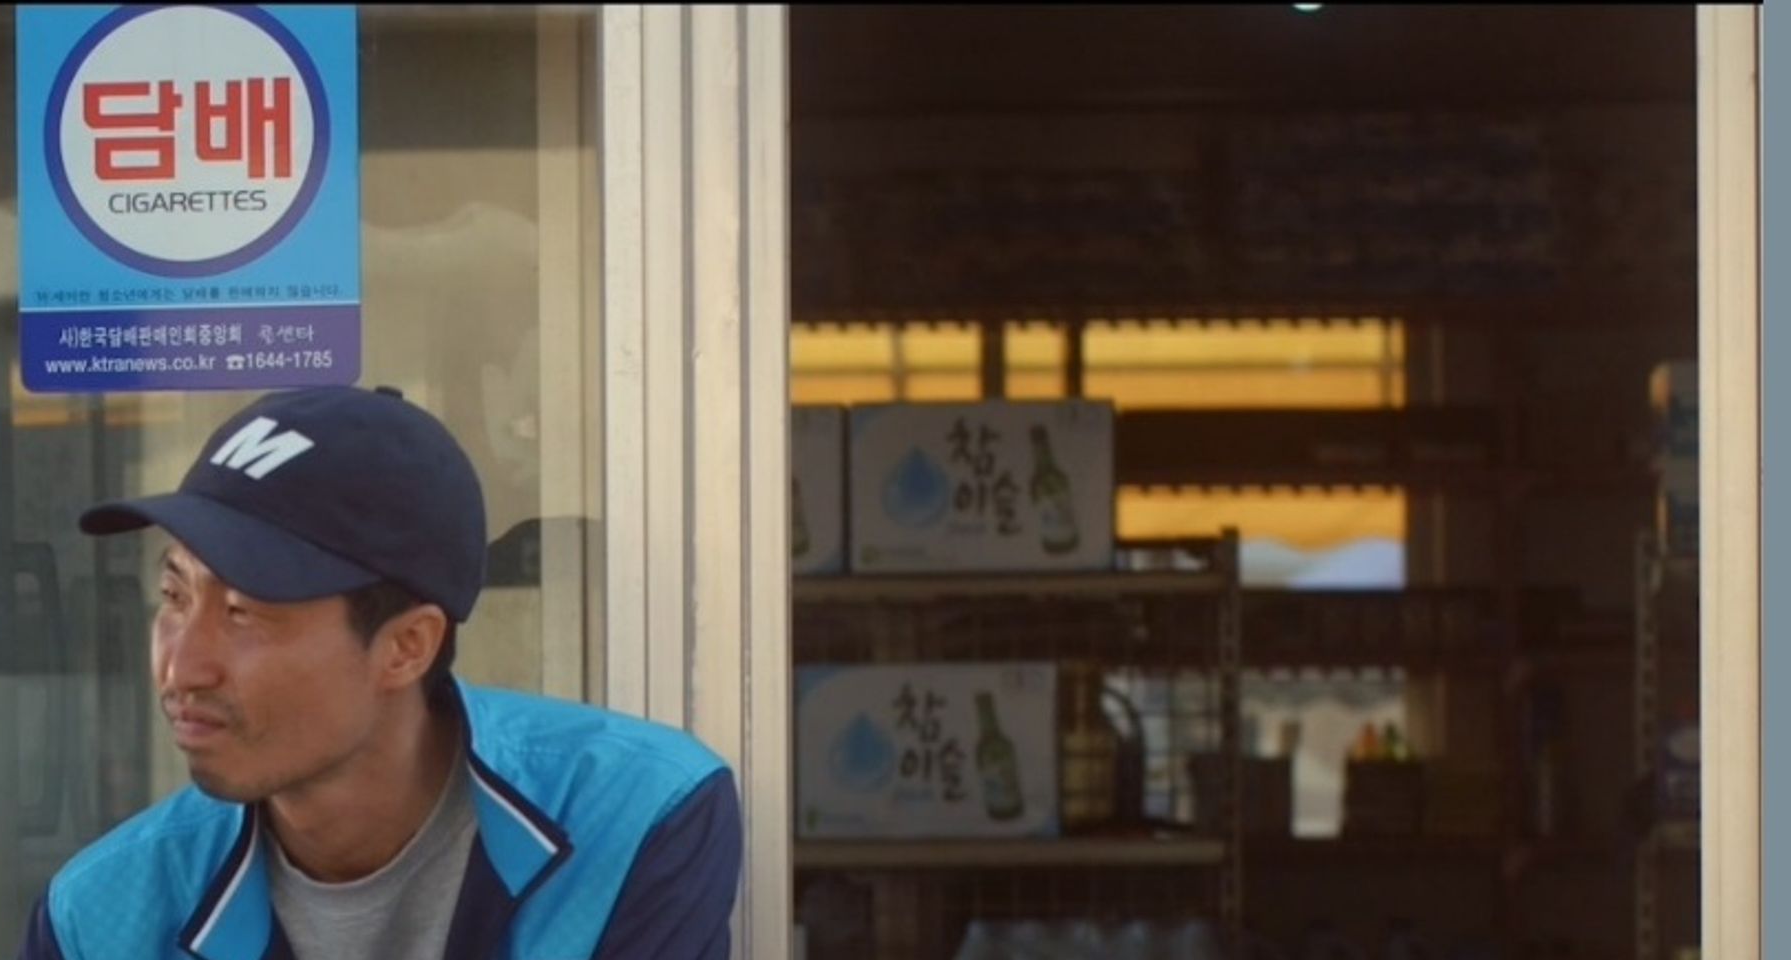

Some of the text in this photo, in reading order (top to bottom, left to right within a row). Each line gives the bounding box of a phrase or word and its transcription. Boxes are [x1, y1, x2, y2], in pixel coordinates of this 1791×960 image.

[82, 75, 292, 181] 담배
[107, 189, 268, 215] CIGARETTES
[44, 352, 216, 375] www.ktranews.co.kr
[209, 415, 315, 481] M
